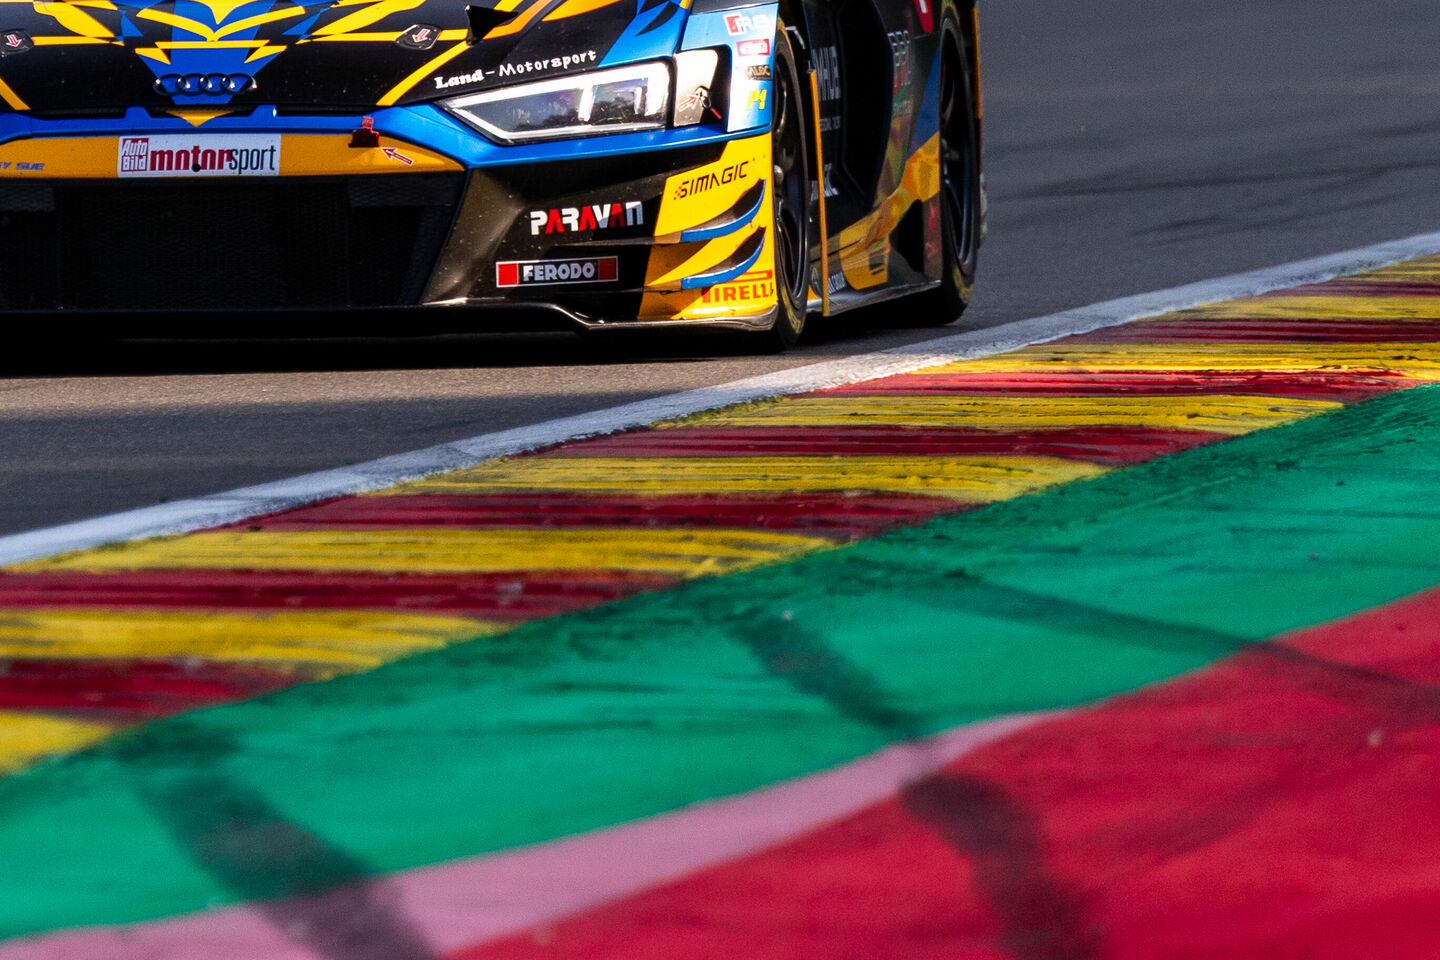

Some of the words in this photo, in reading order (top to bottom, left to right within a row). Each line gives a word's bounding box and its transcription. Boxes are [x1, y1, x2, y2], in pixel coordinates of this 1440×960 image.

[122, 139, 148, 156] Auto
[15, 161, 45, 171] SUE
[122, 156, 147, 171] Bild
[149, 145, 276, 175] motorsport
[679, 160, 749, 199] SIMAGIC
[530, 200, 644, 235] PARAVAN
[522, 262, 596, 283] FERODO
